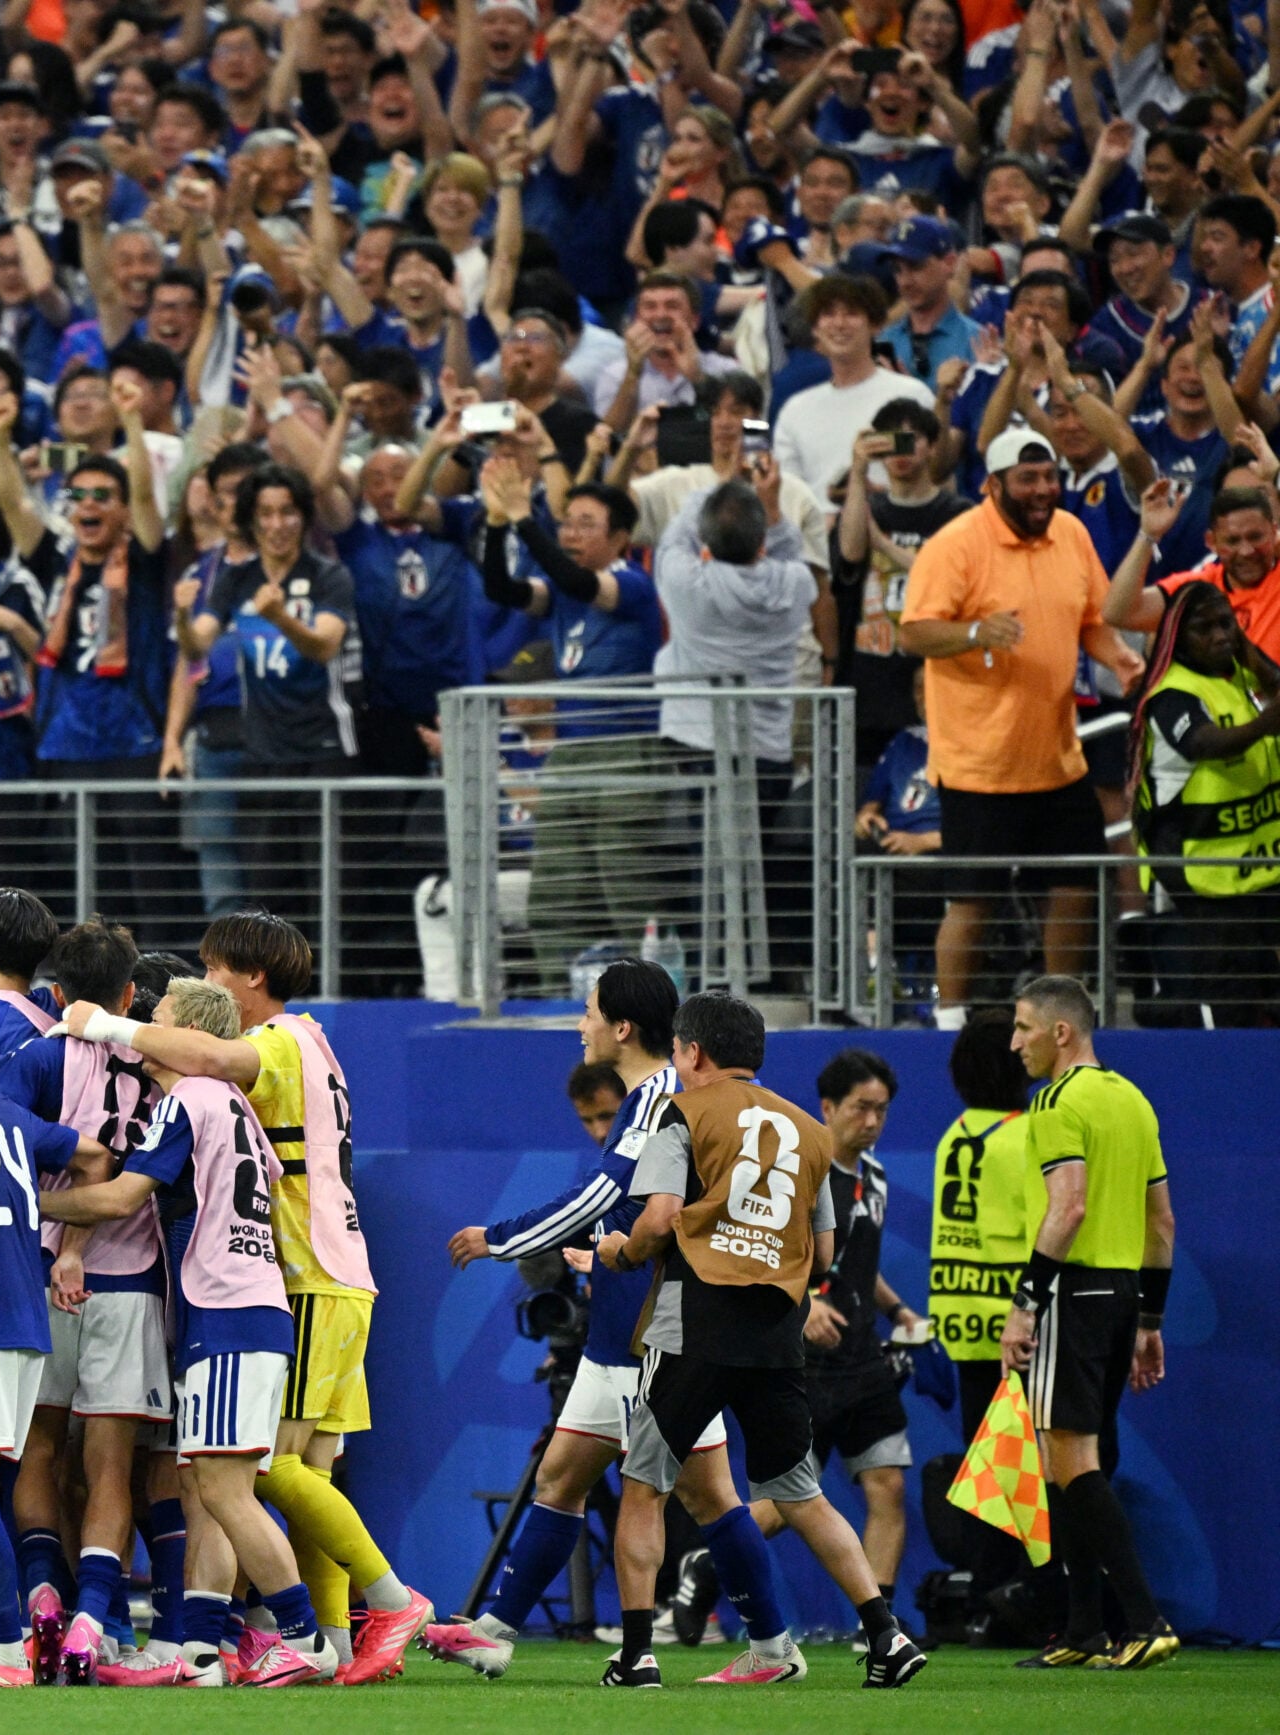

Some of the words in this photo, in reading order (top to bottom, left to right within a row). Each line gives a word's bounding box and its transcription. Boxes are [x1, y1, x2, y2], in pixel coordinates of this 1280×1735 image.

[254, 635, 288, 678] 14
[740, 1198, 774, 1218] FIFA
[229, 1224, 270, 1240] WORLD
[716, 1219, 763, 1241] WORLD
[764, 1232, 784, 1250] CUP
[709, 1233, 781, 1270] 2026
